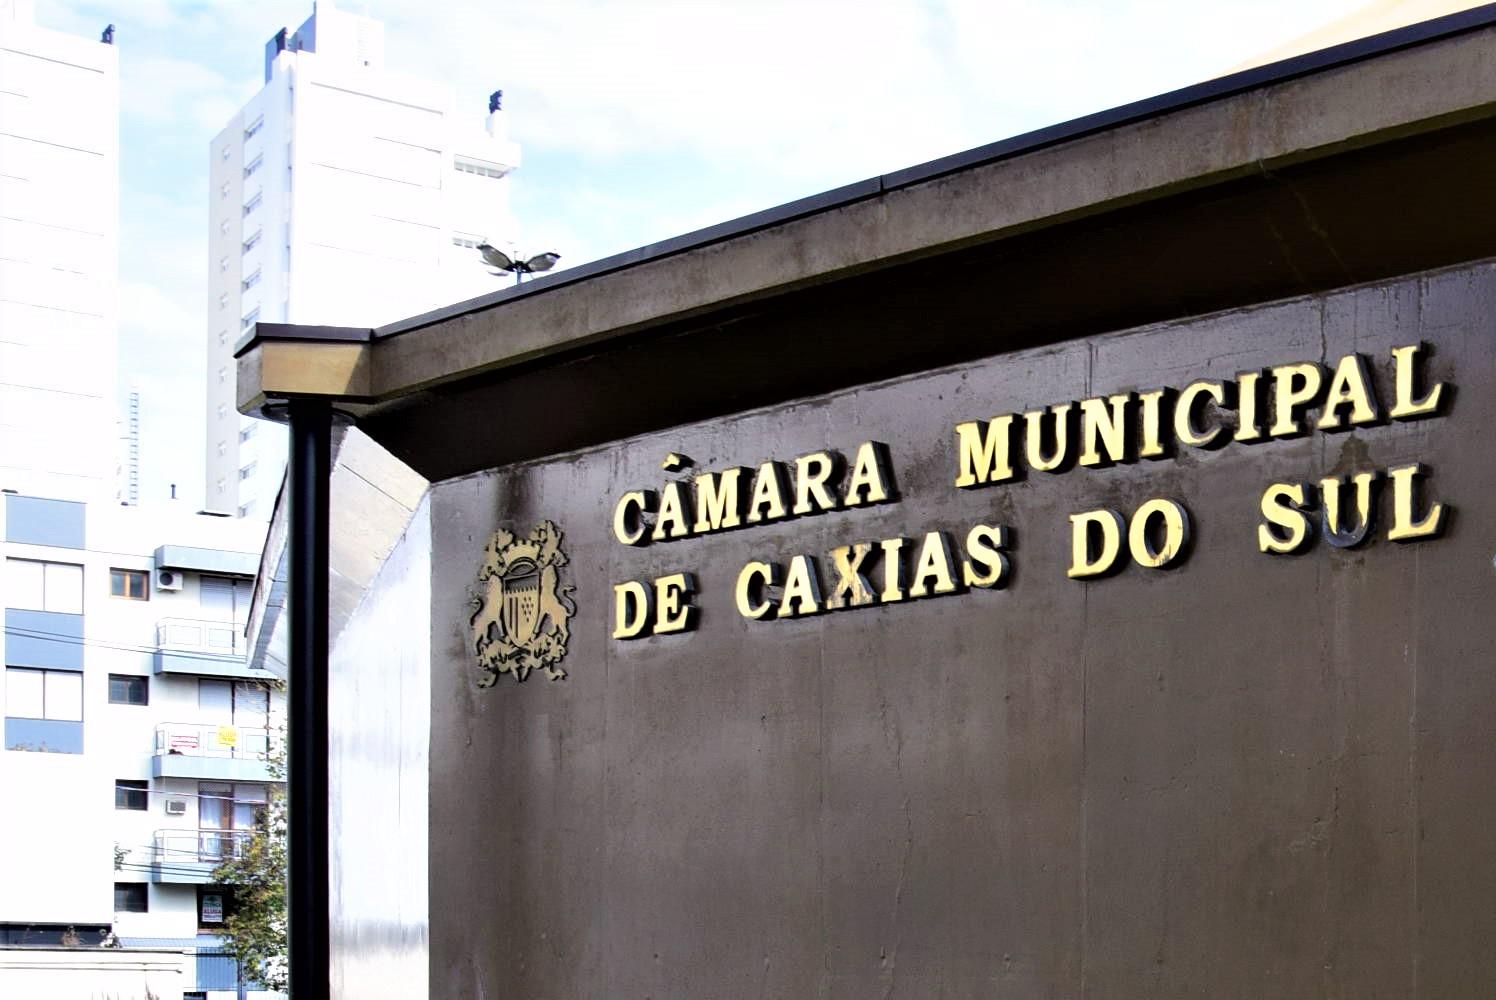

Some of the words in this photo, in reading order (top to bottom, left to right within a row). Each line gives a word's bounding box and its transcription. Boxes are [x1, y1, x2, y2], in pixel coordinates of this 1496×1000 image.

[612, 439, 890, 546] CÂMARA
[953, 344, 1446, 489] MUNICIPAL
[611, 572, 694, 641] DE
[733, 523, 1005, 619] CAXIAS
[1065, 497, 1187, 579] DO
[1257, 464, 1445, 553] SUL
